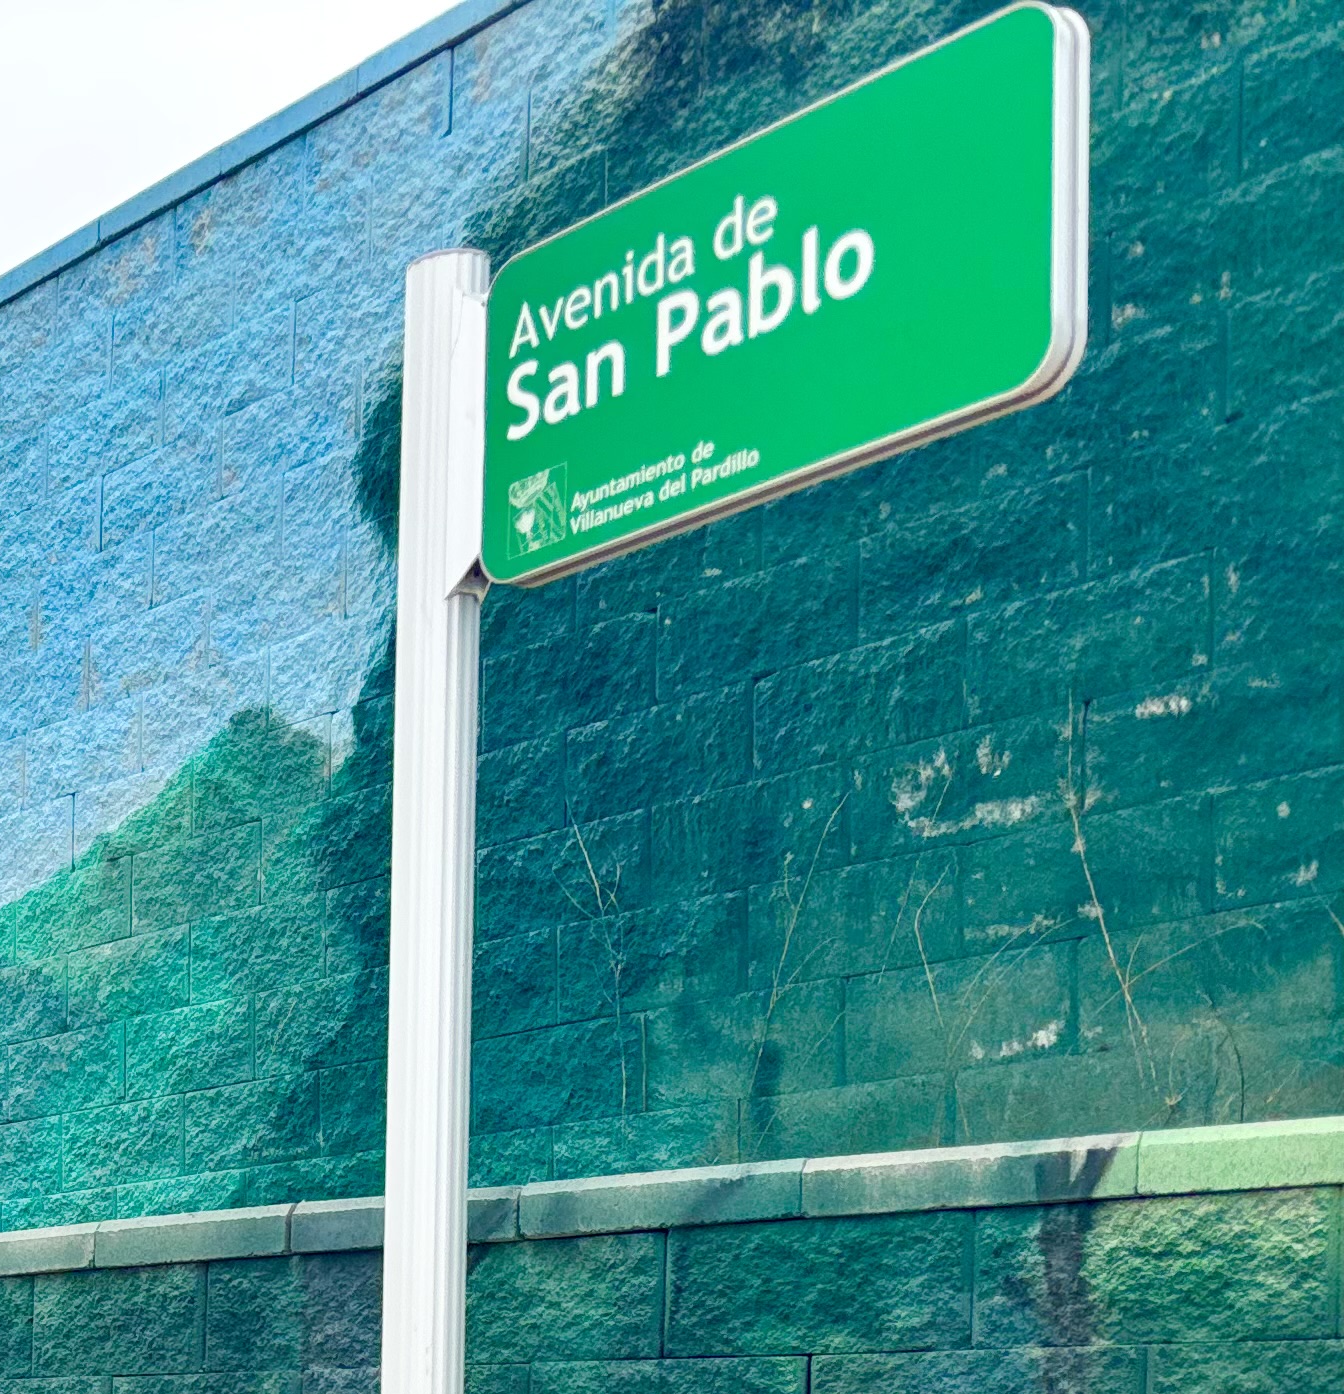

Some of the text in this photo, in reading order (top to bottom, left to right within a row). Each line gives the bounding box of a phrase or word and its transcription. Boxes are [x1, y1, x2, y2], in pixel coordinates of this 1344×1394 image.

[506, 224, 875, 441] San Pablo
[509, 194, 778, 359] Avenida de
[569, 448, 760, 535] Villanueva del Pardillo
[570, 440, 715, 513] Ayuntamiento de
